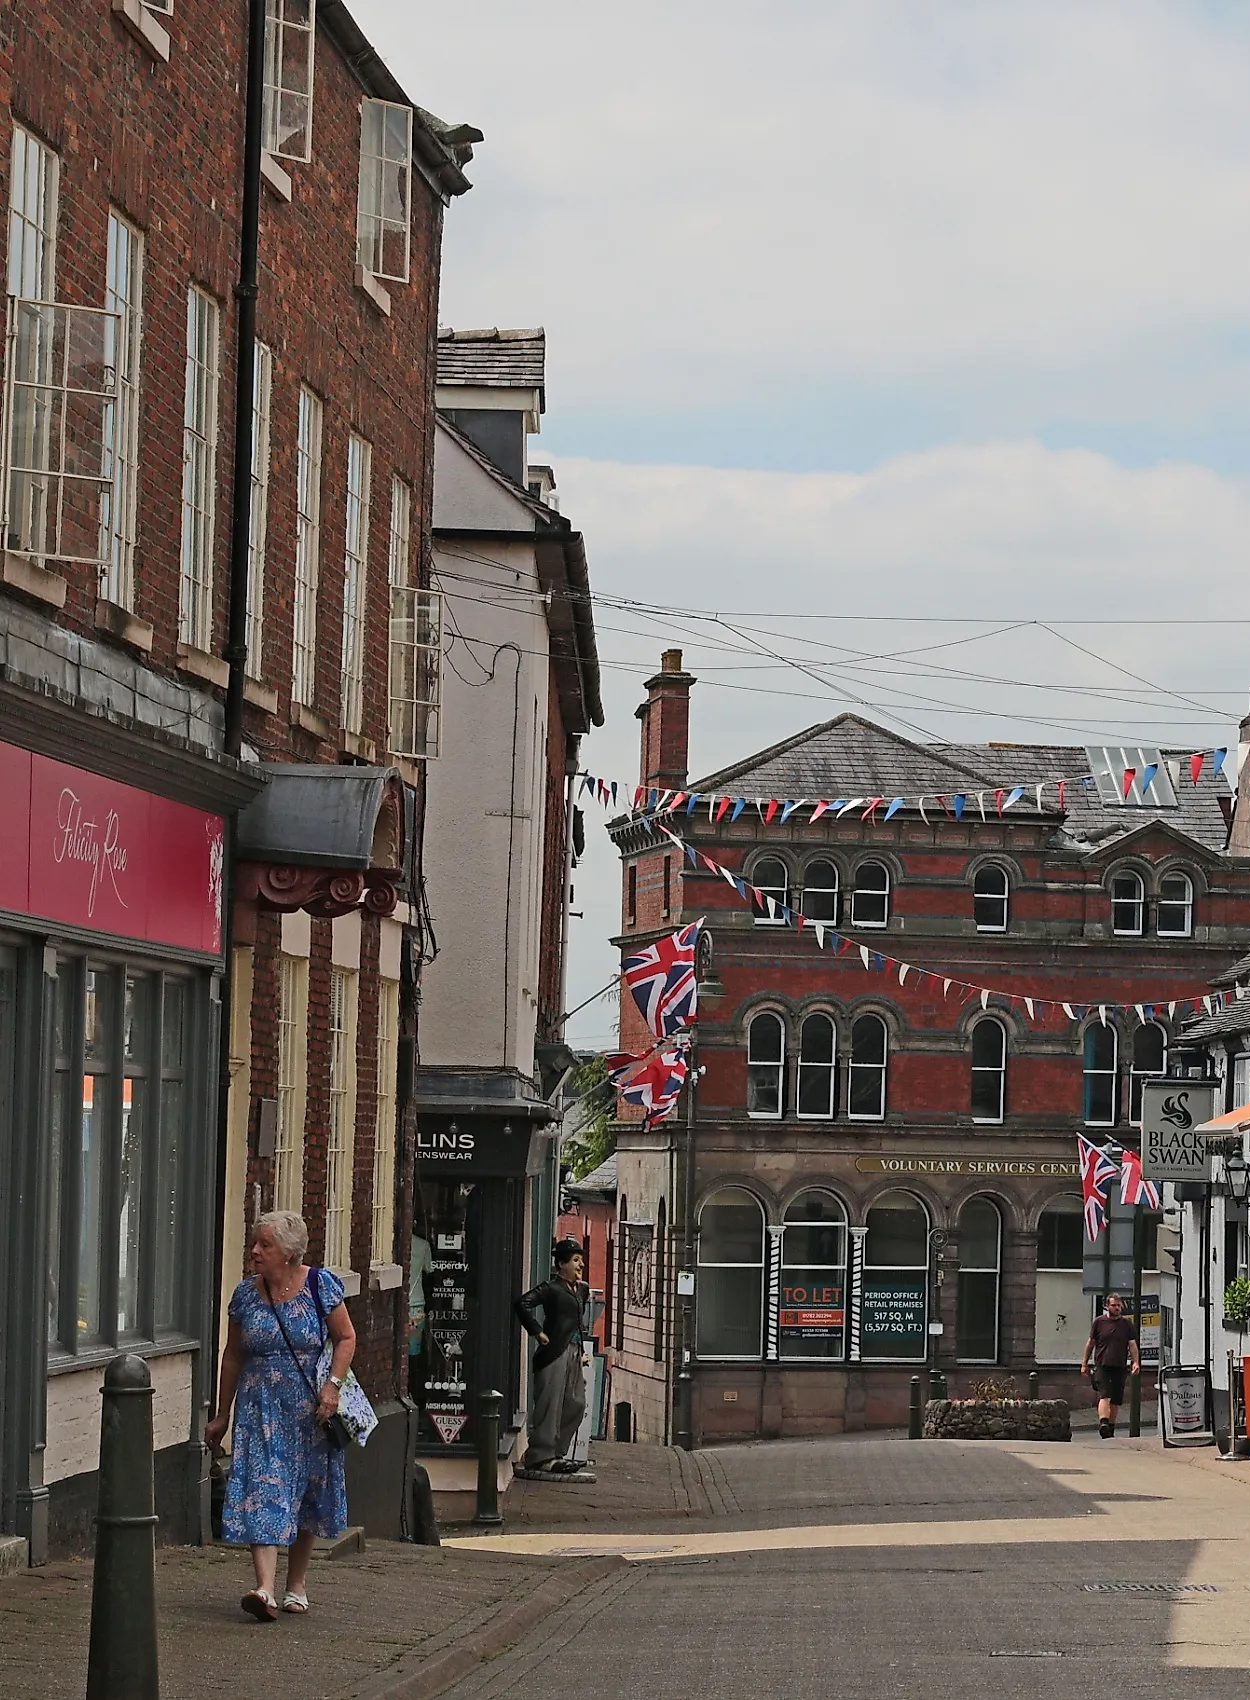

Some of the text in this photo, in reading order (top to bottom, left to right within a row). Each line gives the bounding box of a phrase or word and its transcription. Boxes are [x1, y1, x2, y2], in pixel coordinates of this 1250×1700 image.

[53, 787, 129, 918] Felicity Rose
[417, 1132, 475, 1149] LINS
[1148, 1131, 1204, 1149] BLACK
[1148, 1147, 1205, 1166] SWAN
[880, 1159, 964, 1172] VOLUNTARY
[968, 1161, 1036, 1174] SERVICES
[783, 1287, 843, 1303] TO LET
[892, 1292, 919, 1300] OFFICE
[436, 1311, 468, 1321] LUKE
[874, 1312, 914, 1322] 517 SQ. M
[434, 1331, 463, 1339] GUESS
[864, 1323, 923, 1334] (5,577 SQ. FT.)
[435, 1416, 462, 1425] GUESS
